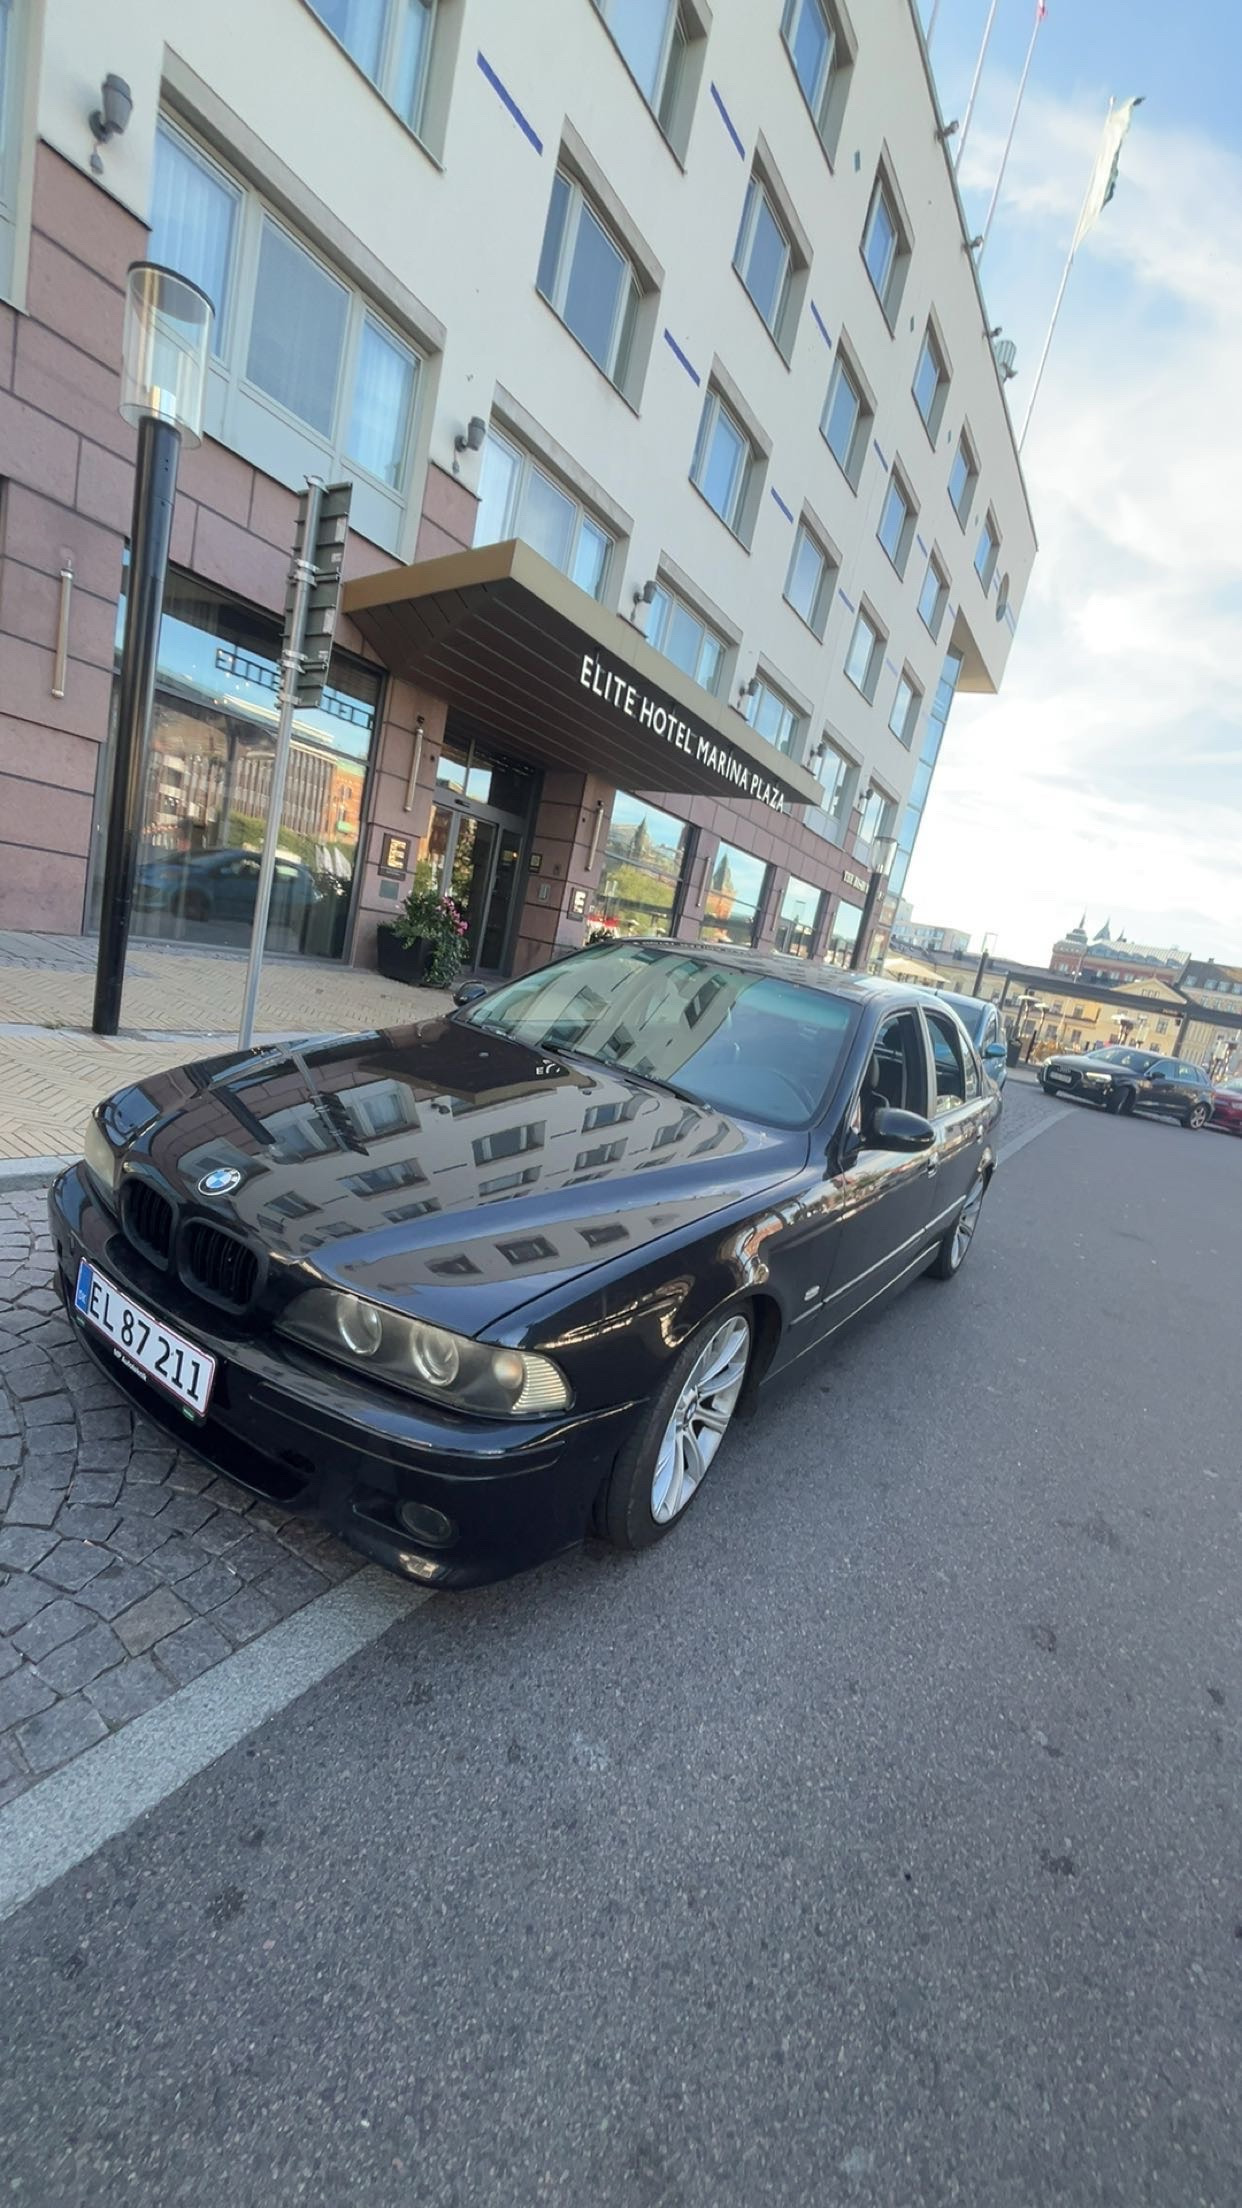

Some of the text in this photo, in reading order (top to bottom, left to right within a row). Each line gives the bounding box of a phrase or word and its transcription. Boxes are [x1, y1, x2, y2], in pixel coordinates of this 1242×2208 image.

[580, 654, 785, 813] ELITE HOTEL MARINA PLAZA
[388, 838, 406, 869] E
[573, 890, 586, 914] E
[89, 1281, 114, 1332] EL
[121, 1309, 151, 1356] 87
[154, 1335, 200, 1401] 211
